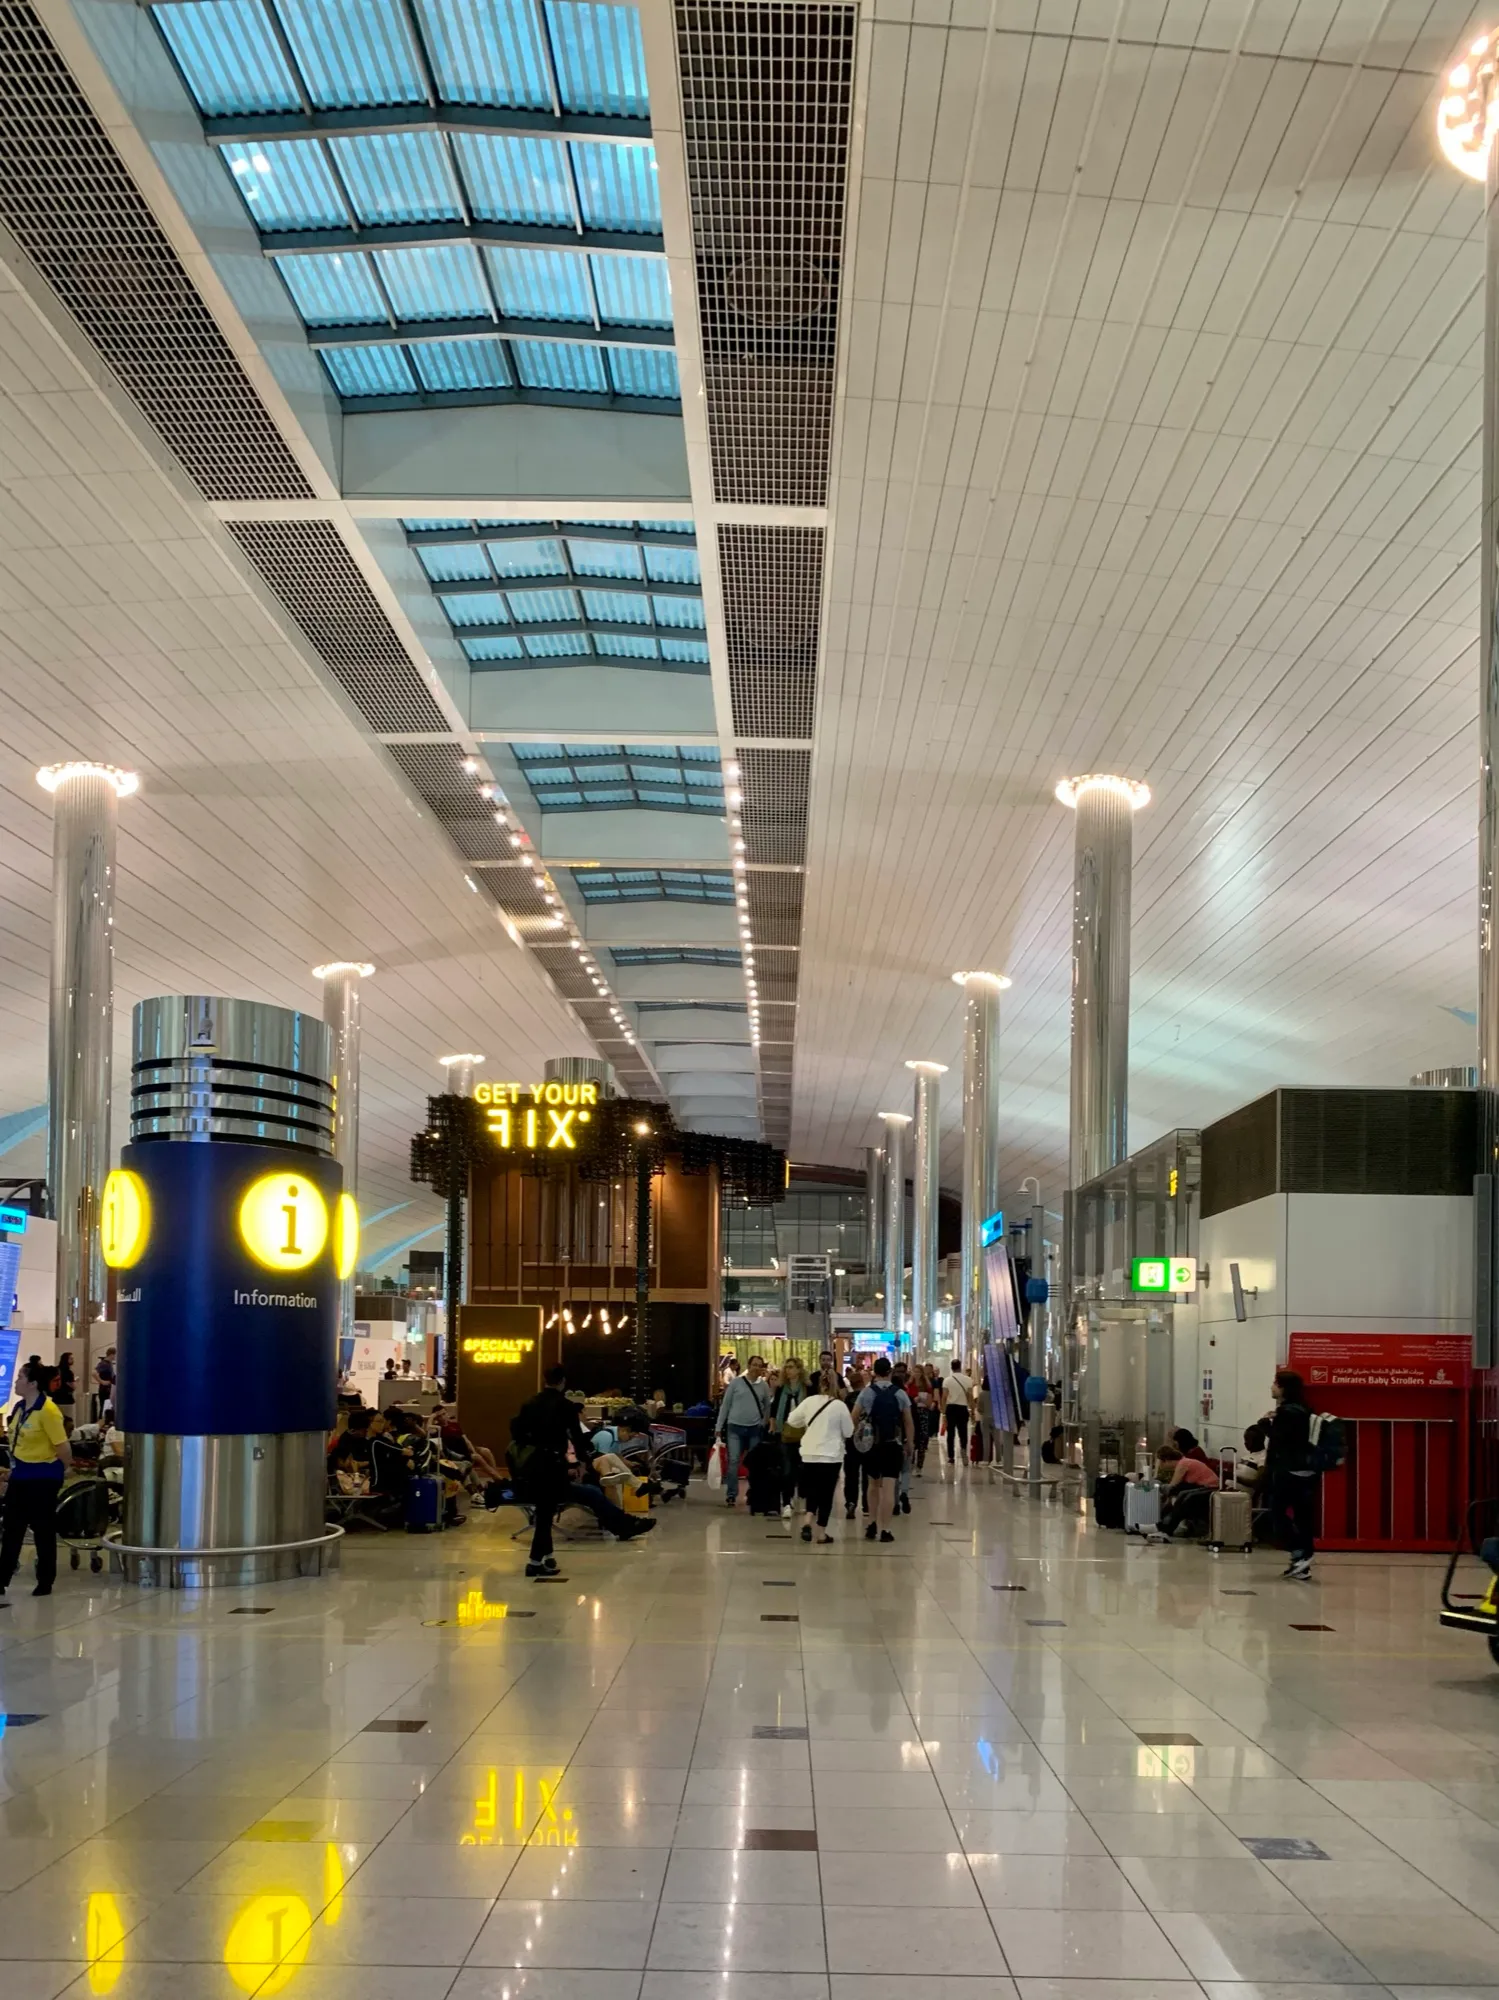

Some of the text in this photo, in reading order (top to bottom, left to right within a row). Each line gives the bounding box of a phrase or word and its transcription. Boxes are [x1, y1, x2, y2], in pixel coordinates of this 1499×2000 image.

[474, 1083, 597, 1105] GET YOUR
[234, 1289, 318, 1309] Information
[463, 1338, 535, 1352] SPECIALTY
[473, 1351, 522, 1364] COFFEE
[1332, 1375, 1425, 1386] Emirates Baby Strollers
